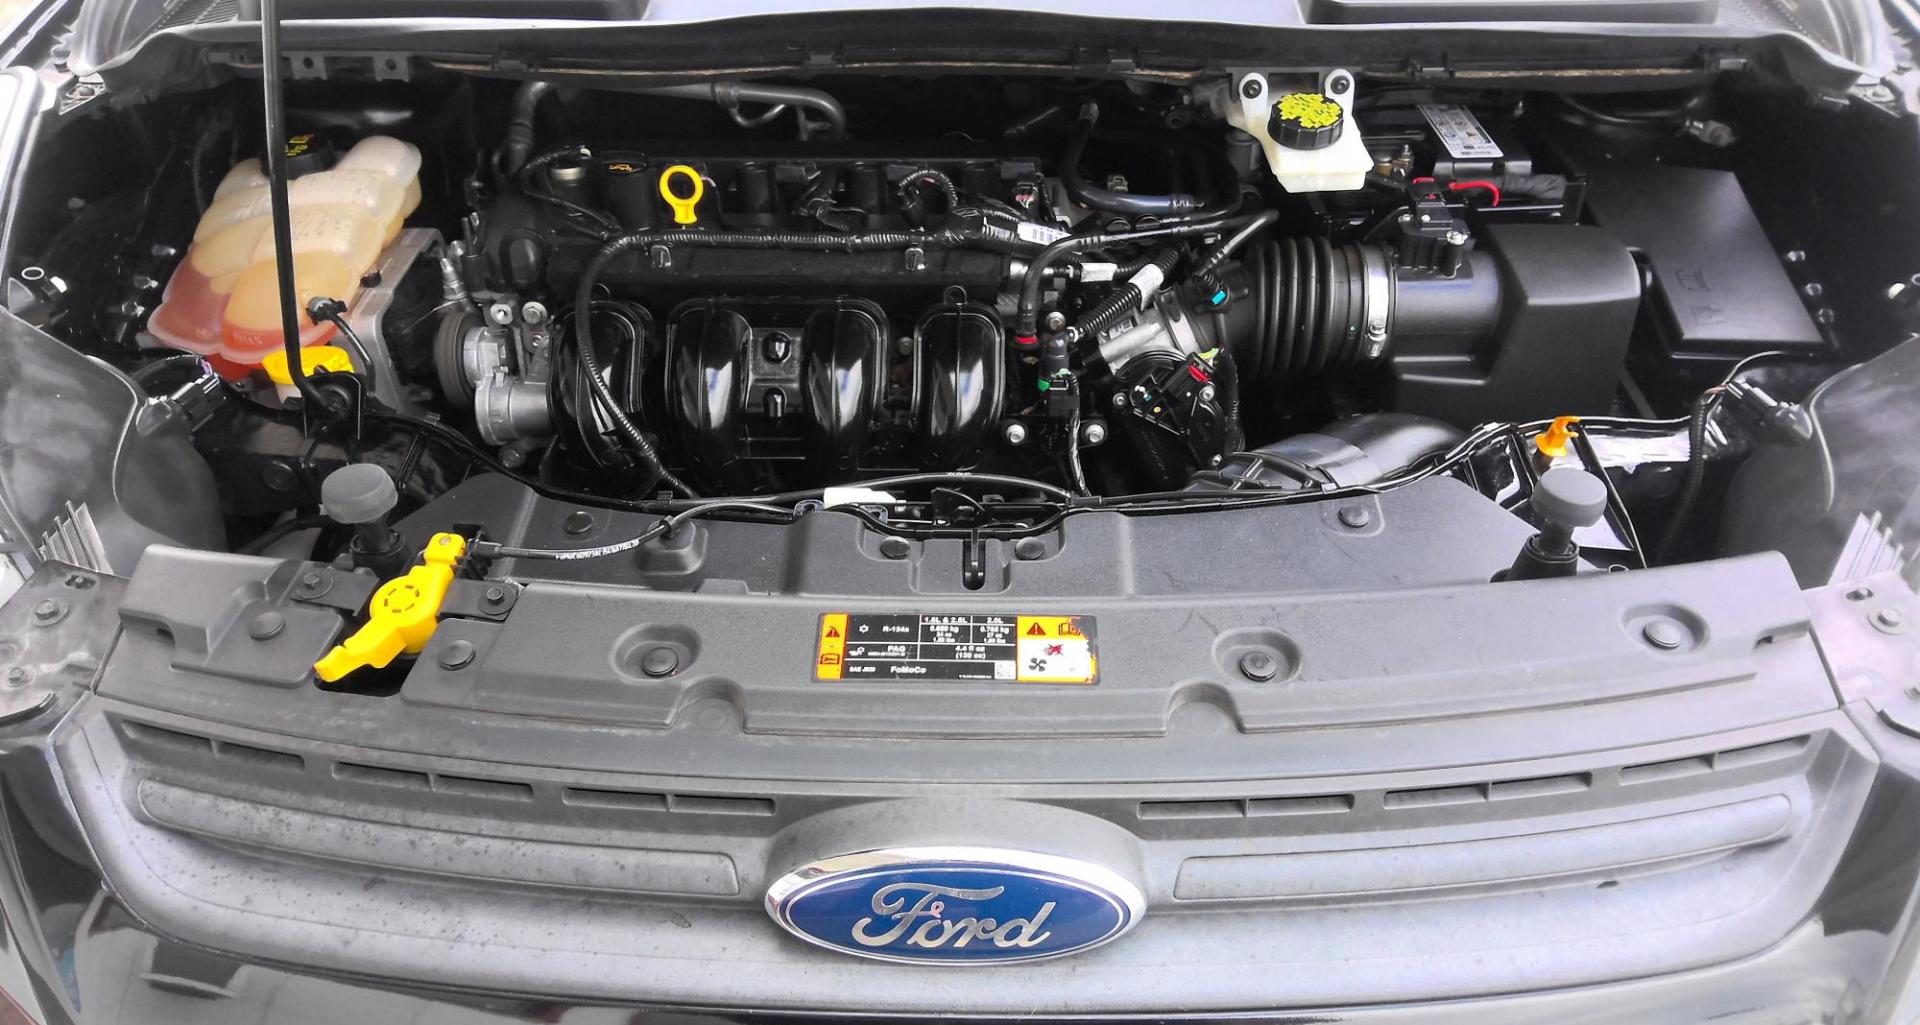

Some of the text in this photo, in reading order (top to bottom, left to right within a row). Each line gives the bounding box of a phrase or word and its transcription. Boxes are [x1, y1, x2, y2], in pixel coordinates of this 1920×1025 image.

[882, 625, 910, 633] R-134a
[890, 666, 927, 674] FoMoCo
[851, 882, 1057, 948] Ford
